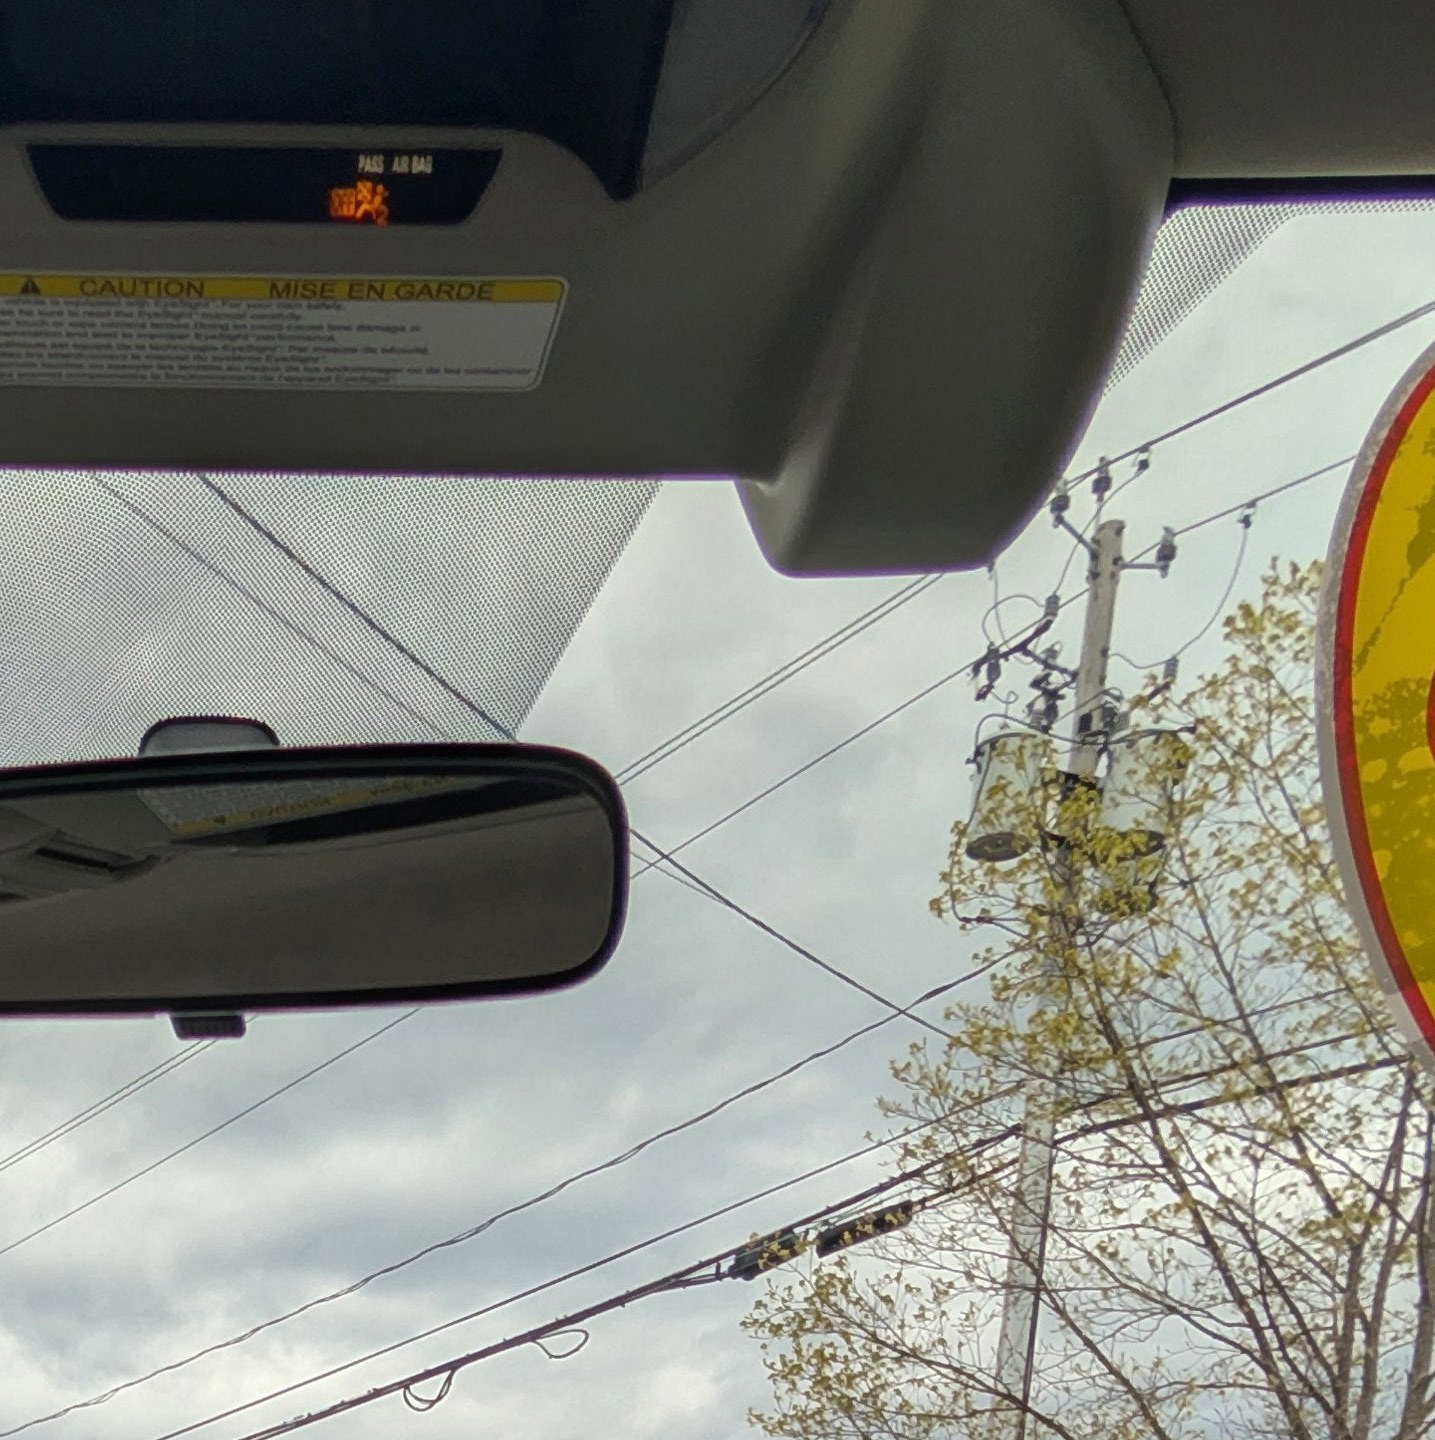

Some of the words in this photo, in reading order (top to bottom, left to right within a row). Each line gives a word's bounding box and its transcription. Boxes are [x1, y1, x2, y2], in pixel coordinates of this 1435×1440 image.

[358, 154, 384, 174] PASS
[392, 154, 410, 174] AIR
[412, 154, 433, 174] BAG
[79, 279, 205, 298] CAUTION
[268, 281, 336, 299] MISE
[348, 281, 383, 300] EN
[395, 282, 496, 301] GARDE
